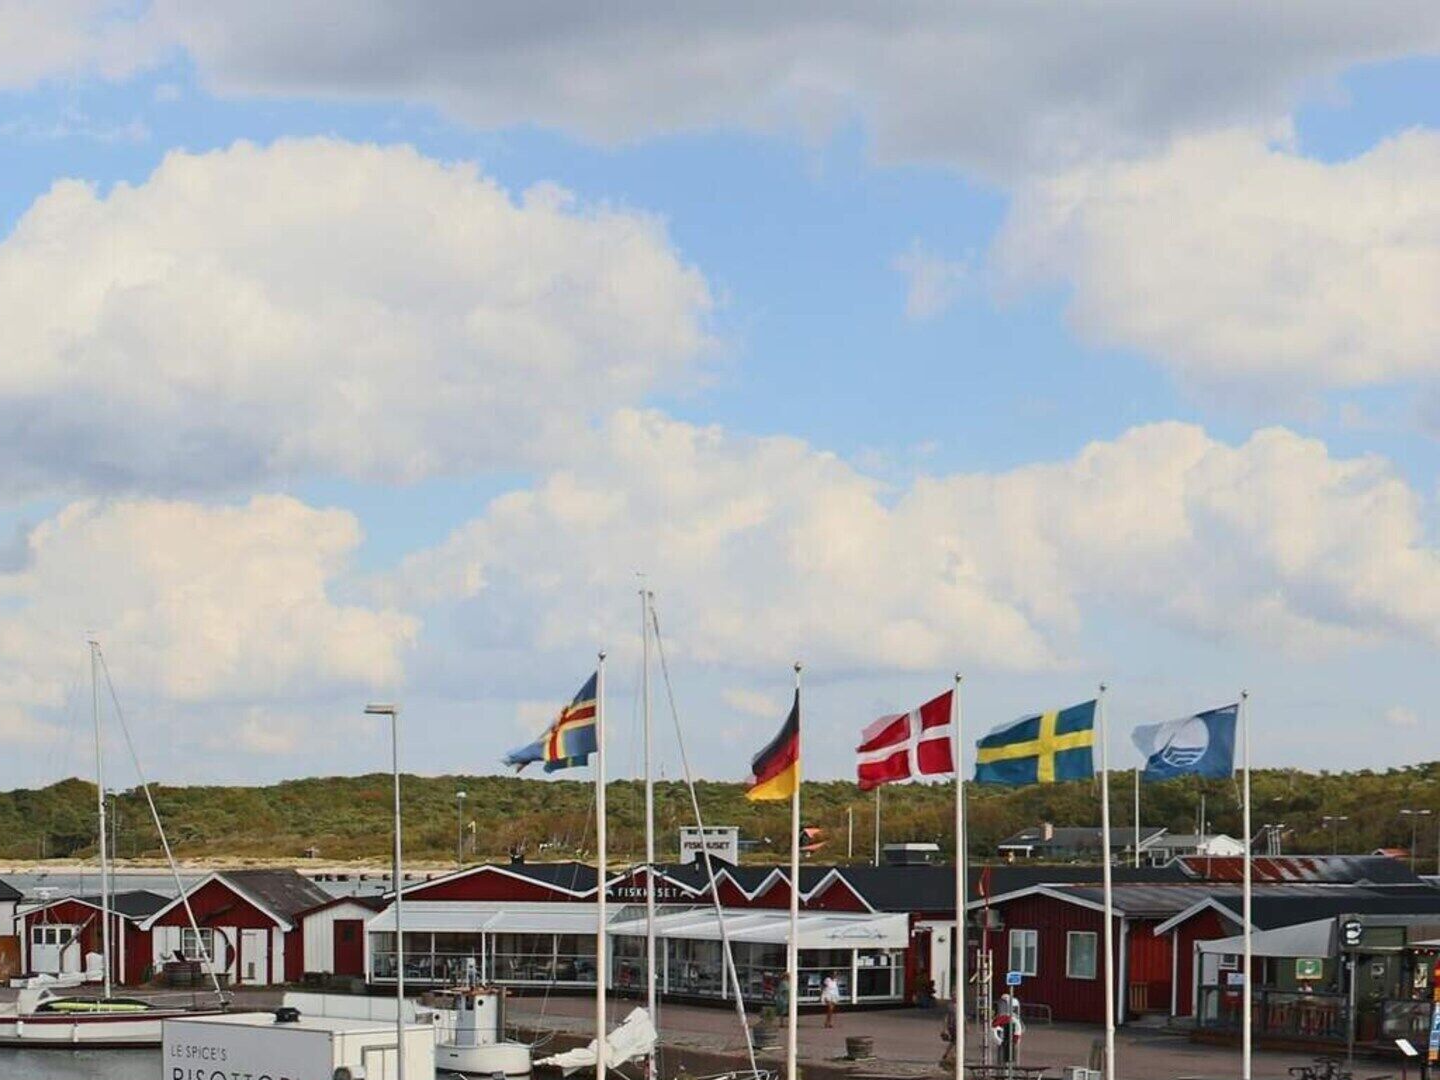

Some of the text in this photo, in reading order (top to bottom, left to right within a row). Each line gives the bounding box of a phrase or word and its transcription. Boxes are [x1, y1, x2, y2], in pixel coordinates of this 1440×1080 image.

[618, 888, 677, 897] FISKHSET
[171, 1044, 228, 1061] LE SPICE'S
